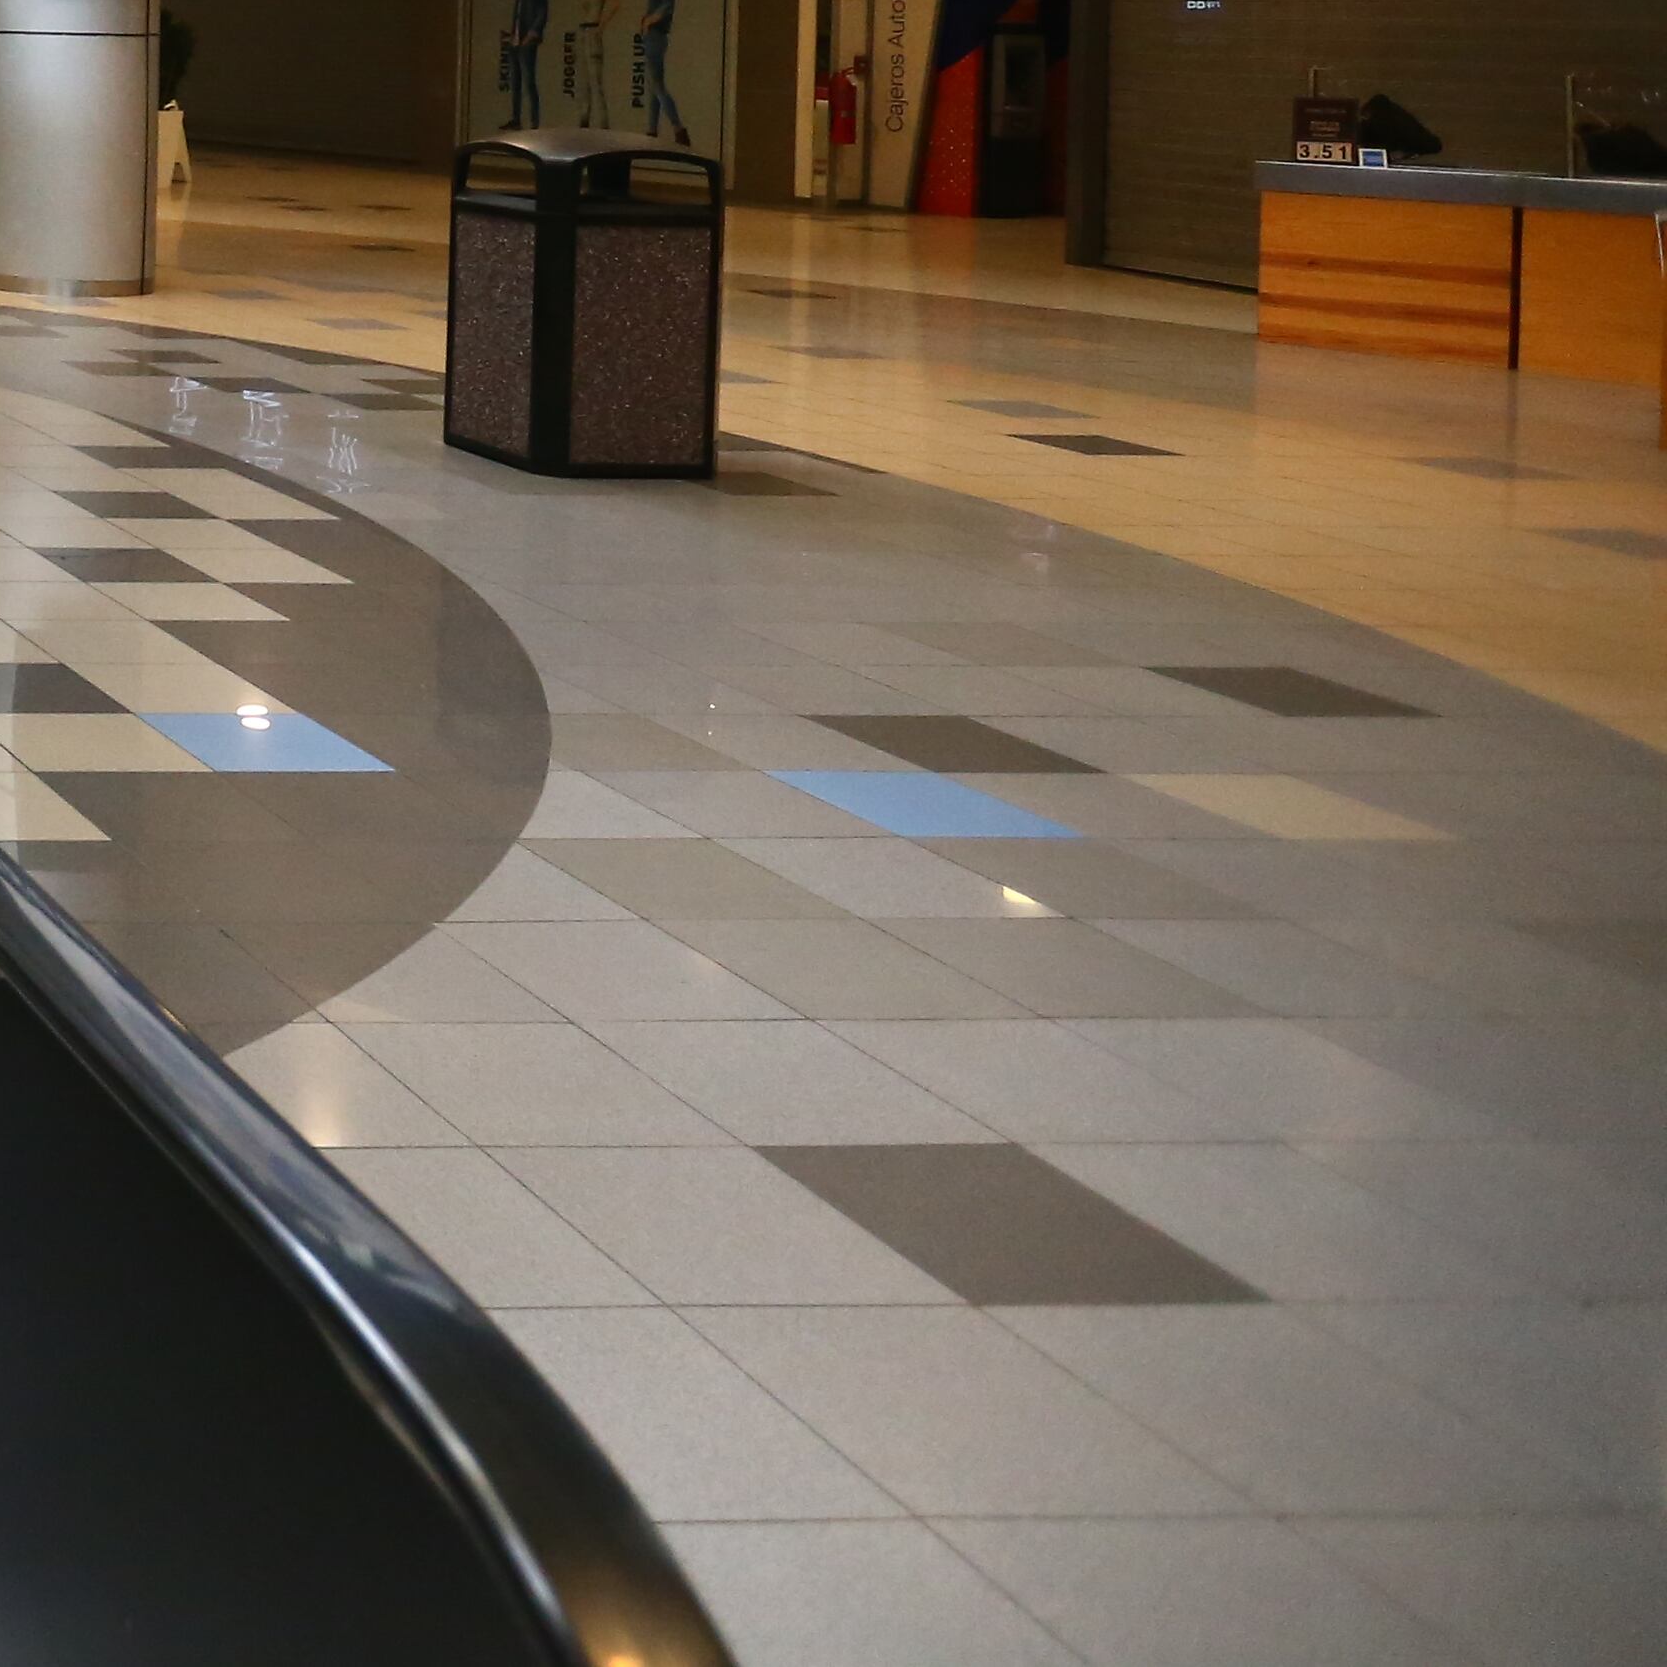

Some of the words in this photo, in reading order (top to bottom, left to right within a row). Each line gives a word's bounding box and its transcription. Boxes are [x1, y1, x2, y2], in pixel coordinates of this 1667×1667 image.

[634, 33, 646, 58] UP
[632, 60, 646, 109] PUSH
[885, 53, 909, 133] Cajeros
[1299, 143, 1348, 160] 3.51
